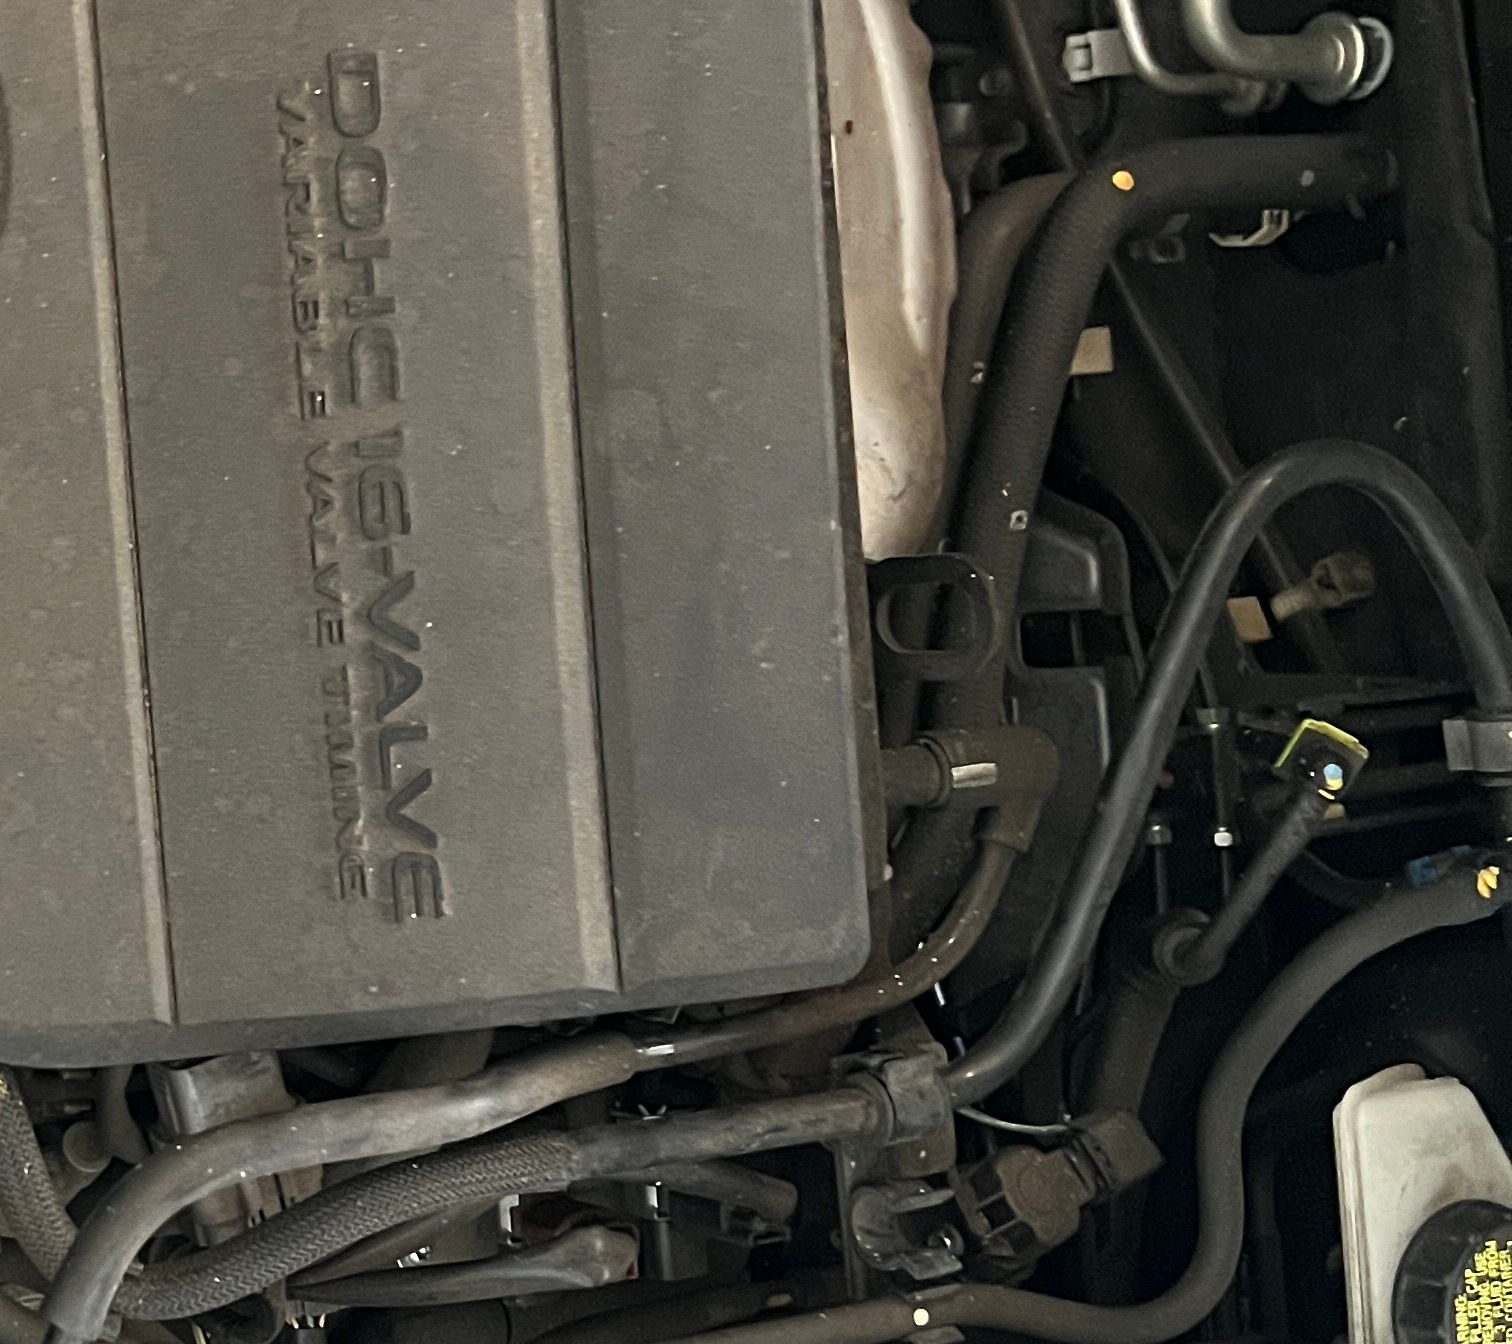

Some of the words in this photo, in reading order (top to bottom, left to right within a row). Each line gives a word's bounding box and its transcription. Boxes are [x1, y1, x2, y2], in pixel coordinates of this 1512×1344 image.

[327, 49, 401, 405] DOHC
[276, 78, 329, 423] VARIABLE
[304, 439, 347, 649] VALVE
[352, 420, 449, 925] 16-VALVE
[317, 661, 369, 903] TIMING
[1474, 1251, 1488, 1276] USE
[1485, 1240, 1500, 1277] FROM
[1465, 1268, 1478, 1293] CAP
[1490, 1281, 1505, 1318] FLUID
[1467, 1300, 1481, 1343] FILLER
[1493, 1325, 1505, 1333] 3
